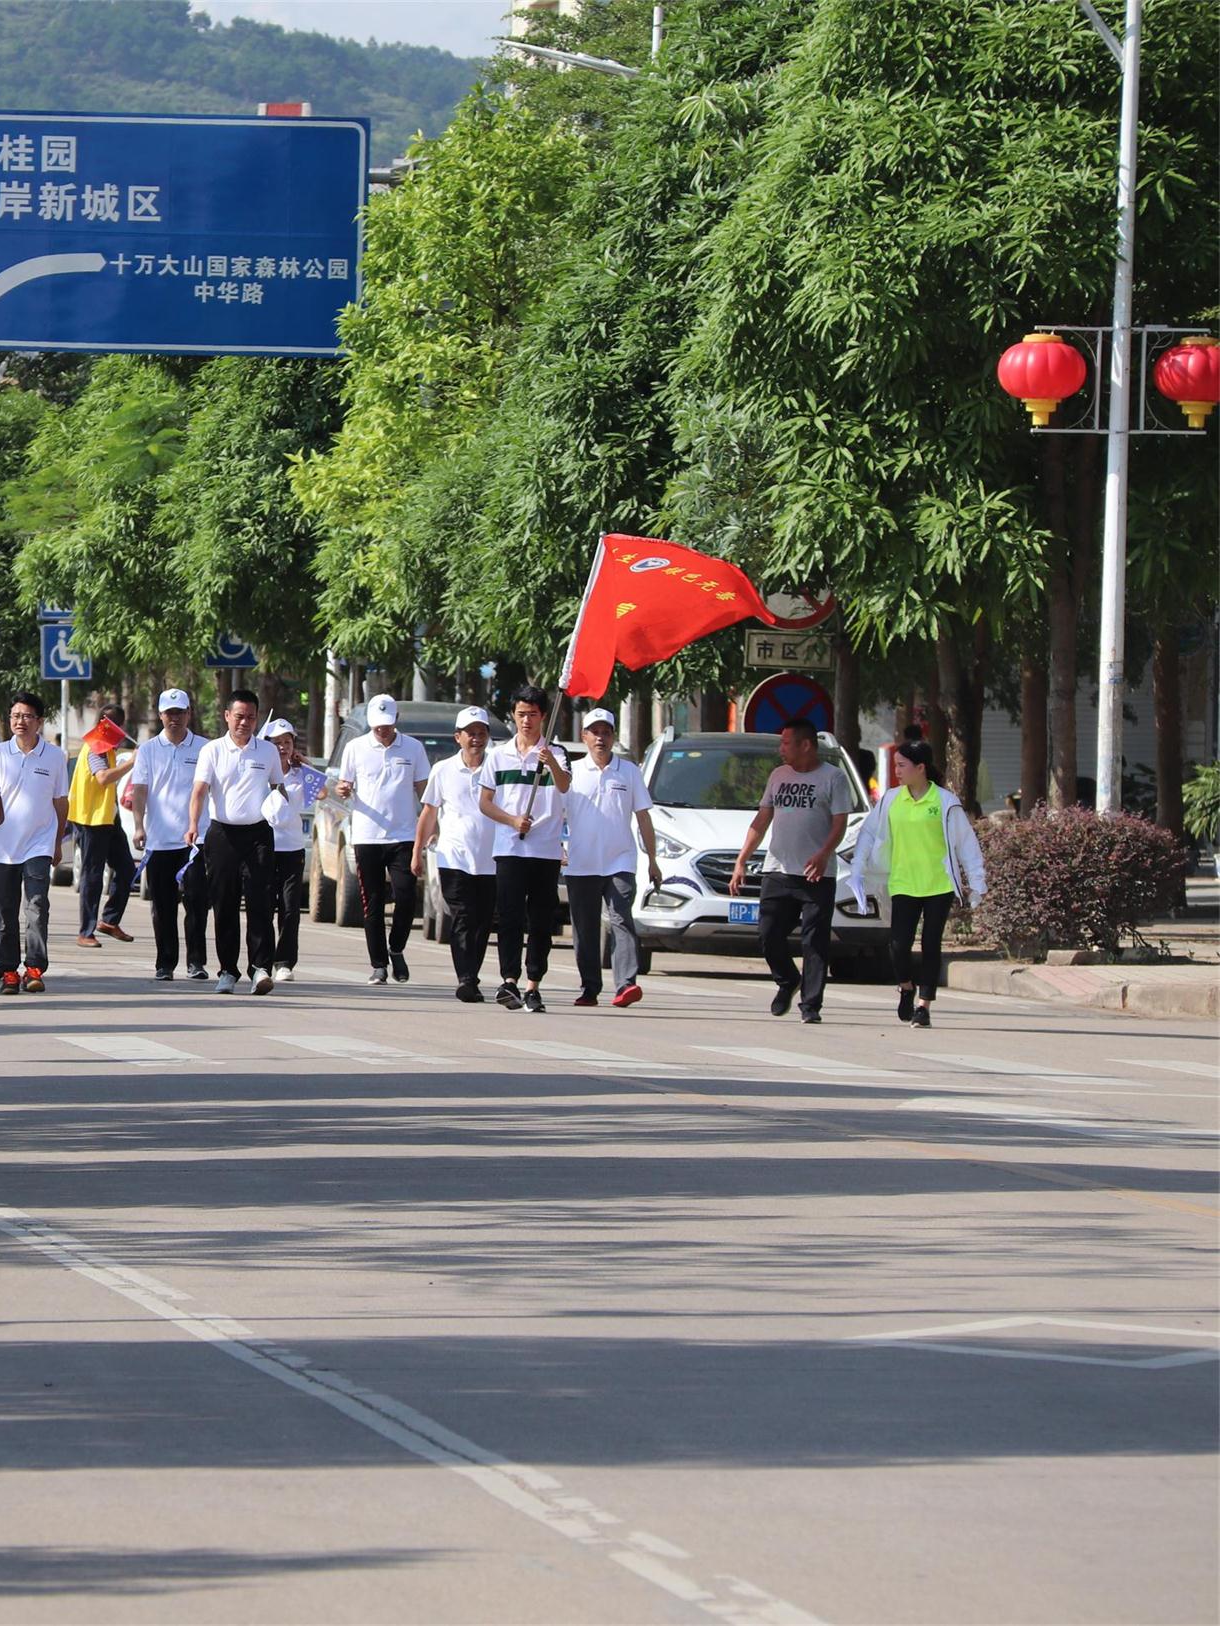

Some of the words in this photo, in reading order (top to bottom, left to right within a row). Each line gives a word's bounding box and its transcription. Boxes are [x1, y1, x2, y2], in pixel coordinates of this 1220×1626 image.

[109, 253, 349, 280] 十万大山国家森林公园
[194, 281, 264, 304] 中华路
[778, 782, 816, 796] MORE
[774, 794, 817, 809] MONEY
